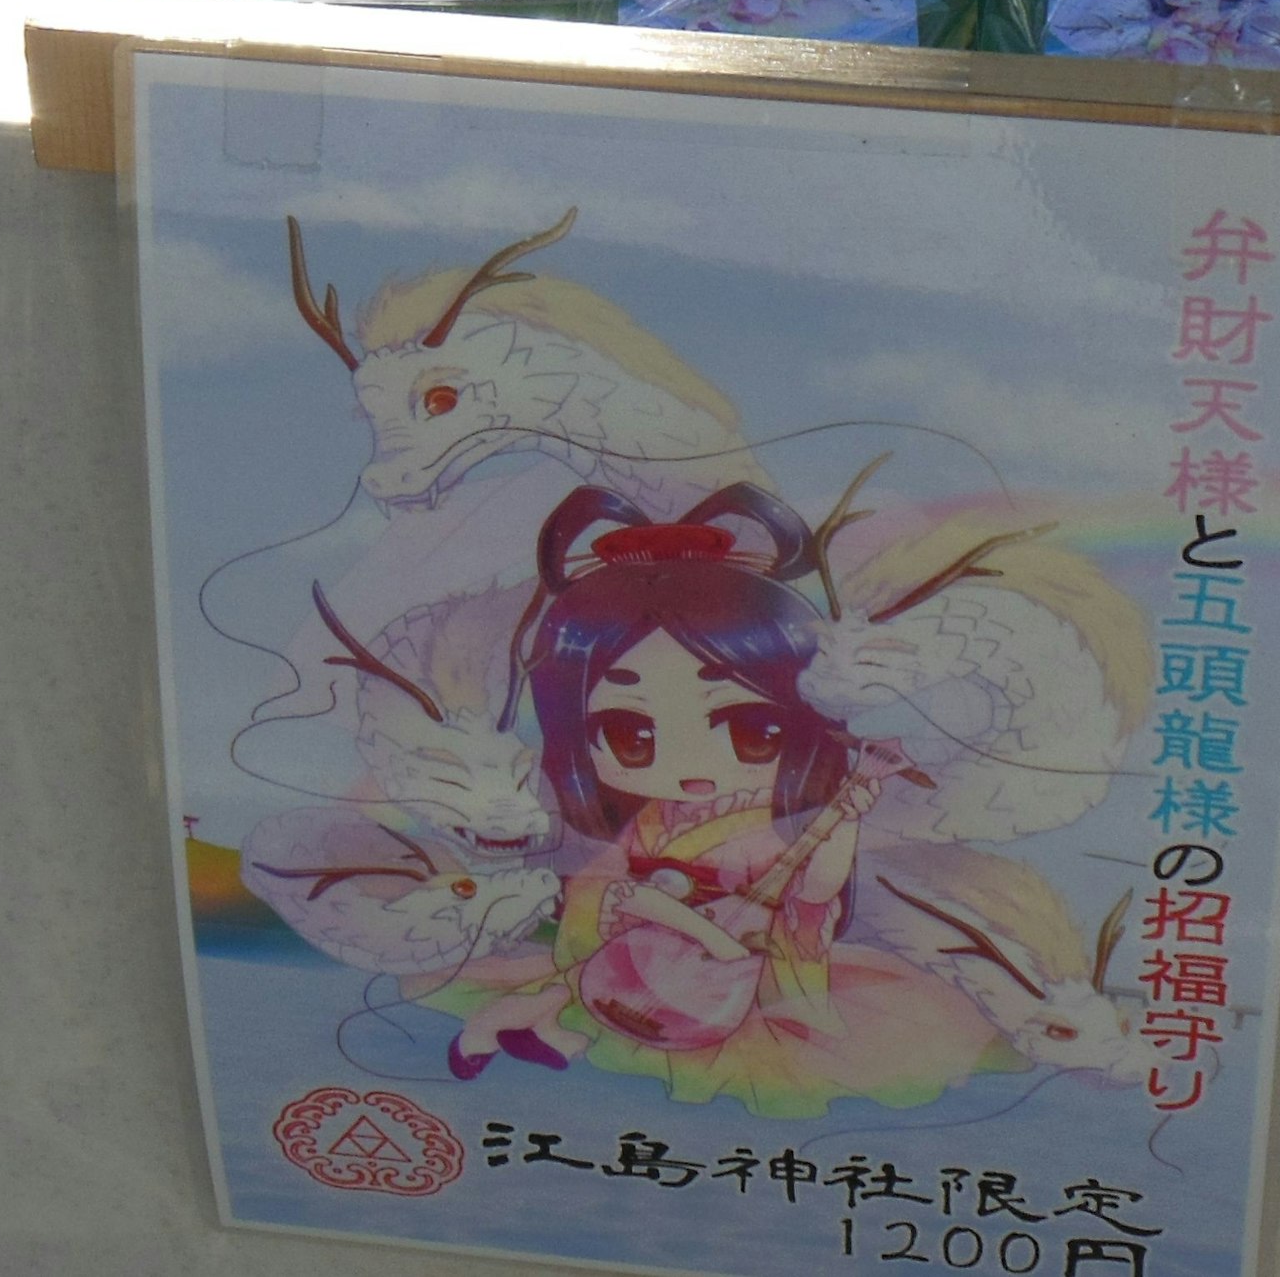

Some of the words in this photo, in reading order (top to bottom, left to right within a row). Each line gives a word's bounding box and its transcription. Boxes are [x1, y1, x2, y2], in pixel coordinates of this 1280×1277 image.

[1138, 208, 1277, 1111] 弁財天様と五頭龍様の招福守り
[484, 1121, 1163, 1236] 江島神社限定
[841, 1218, 1148, 1277] 1200円
